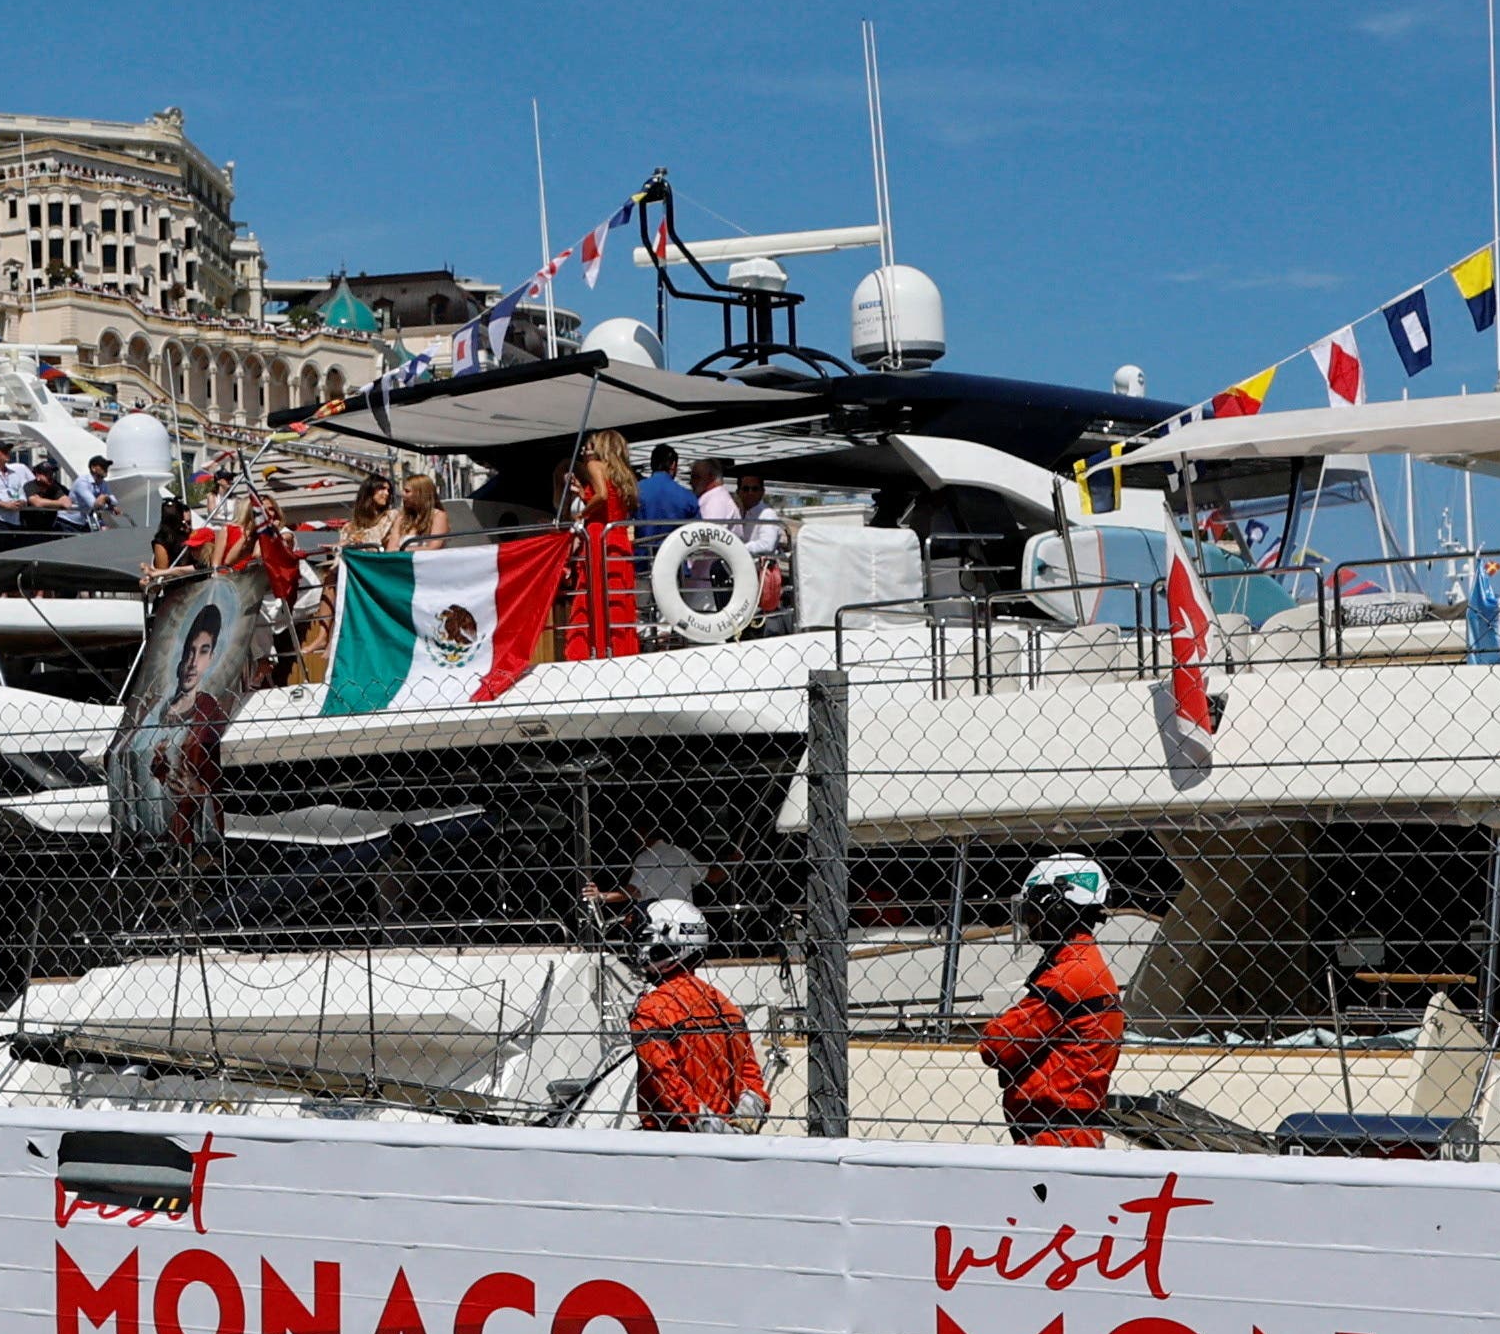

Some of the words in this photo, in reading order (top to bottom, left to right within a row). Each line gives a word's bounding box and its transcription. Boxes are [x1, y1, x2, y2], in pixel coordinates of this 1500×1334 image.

[680, 528, 734, 547] CARRAZO
[687, 615, 711, 633] Road
[717, 599, 750, 631] Habour
[933, 1171, 1214, 1299] visit
